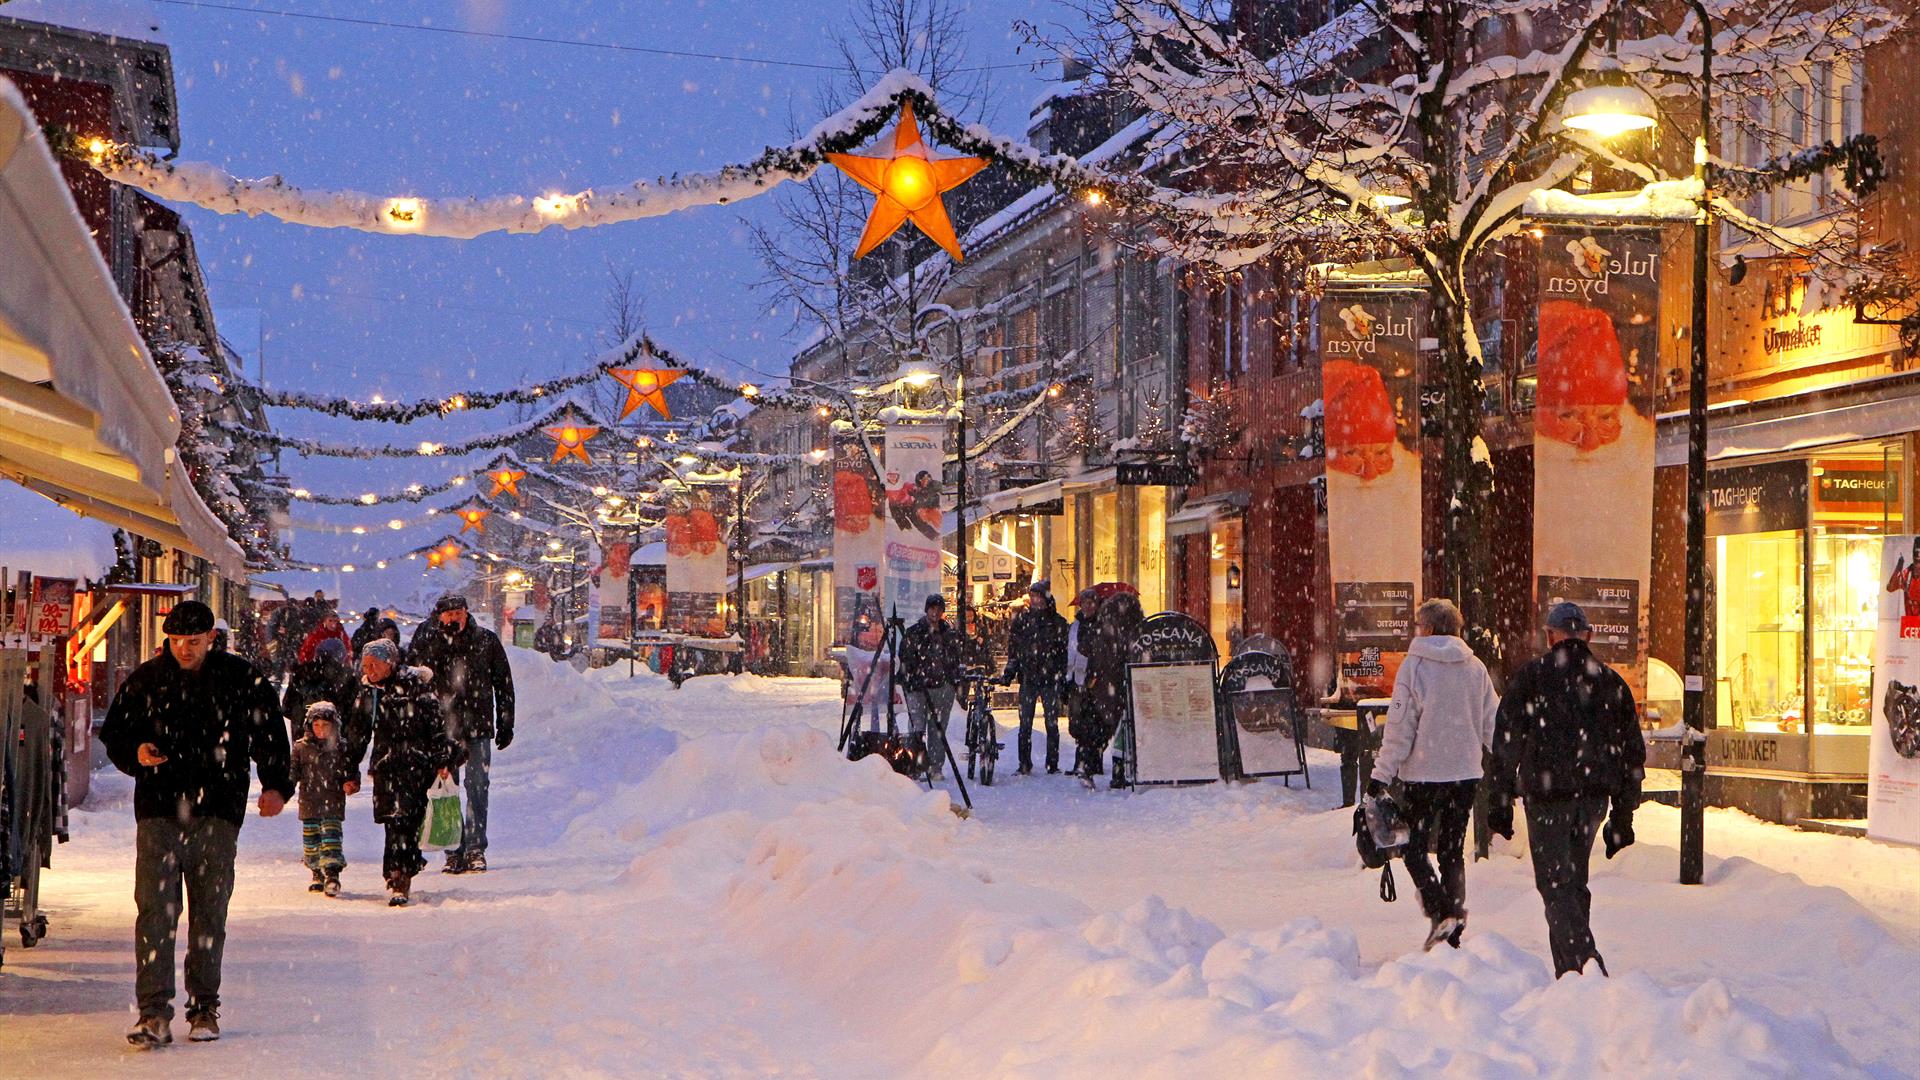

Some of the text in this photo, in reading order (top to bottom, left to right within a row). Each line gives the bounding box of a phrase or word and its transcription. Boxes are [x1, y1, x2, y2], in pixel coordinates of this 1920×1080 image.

[1132, 627, 1203, 652] TOSCANA
[1228, 663, 1281, 682] TOSCANA
[1721, 738, 1778, 762] URMAKER
